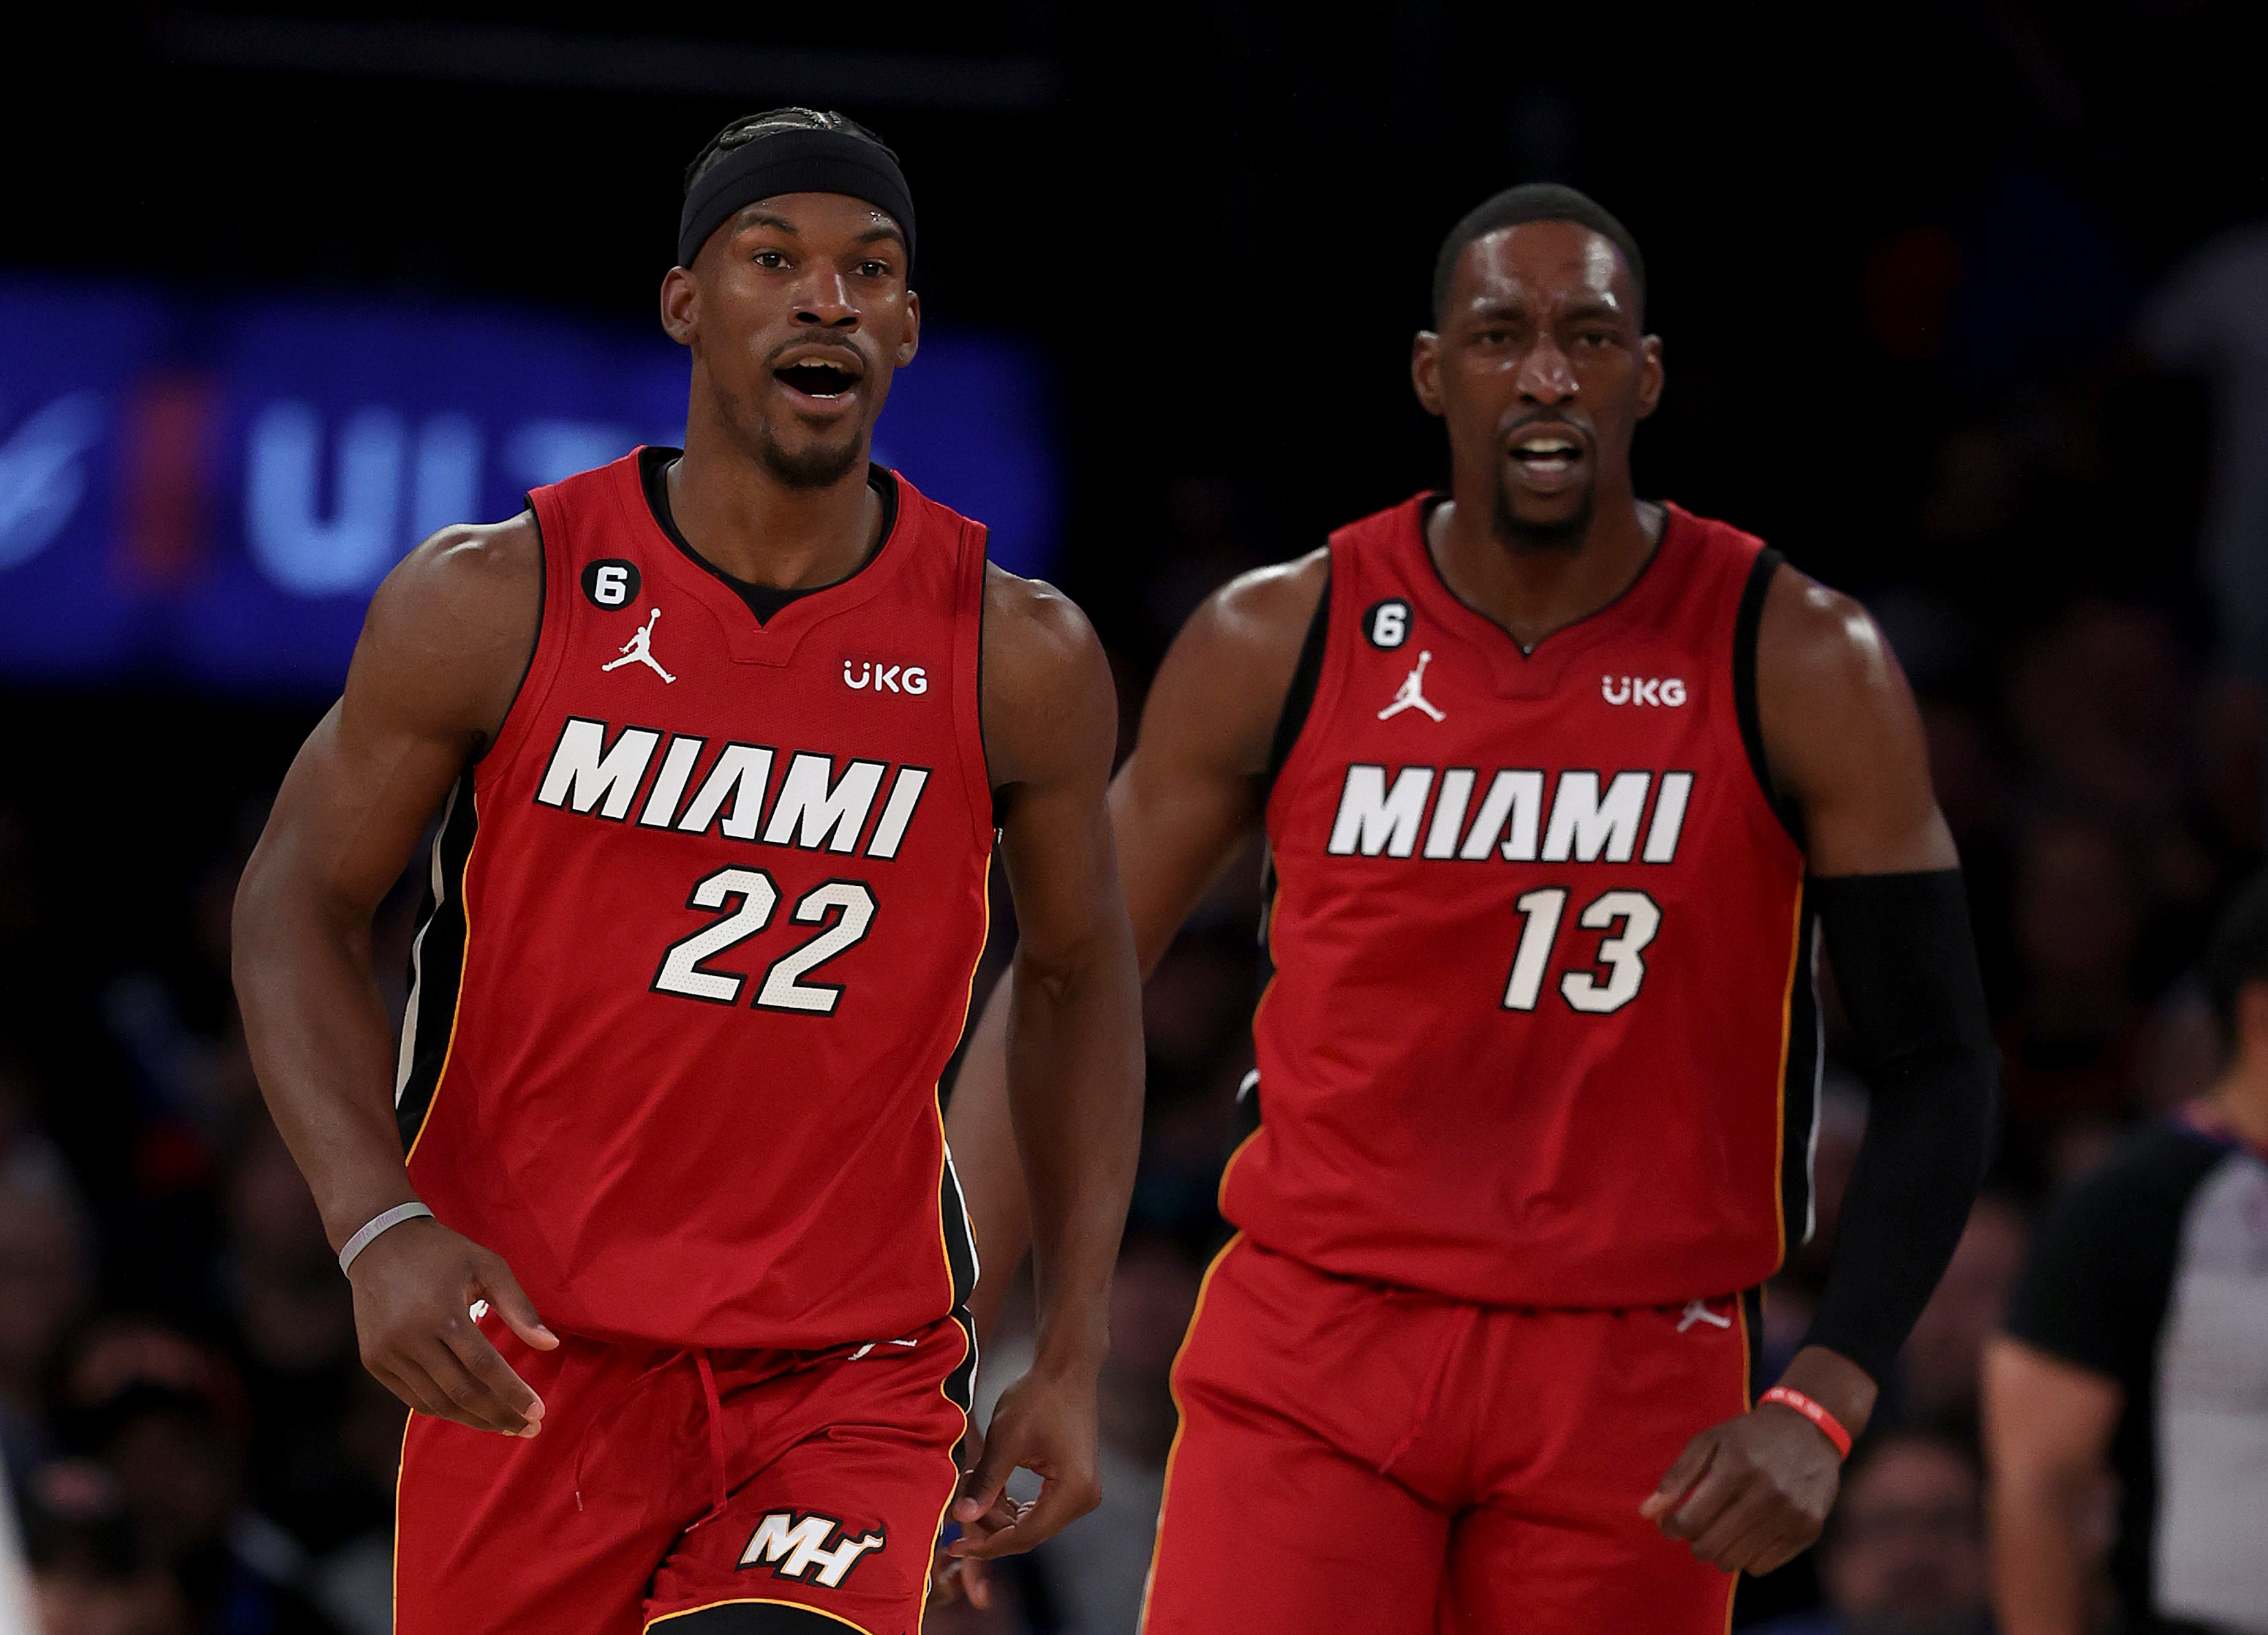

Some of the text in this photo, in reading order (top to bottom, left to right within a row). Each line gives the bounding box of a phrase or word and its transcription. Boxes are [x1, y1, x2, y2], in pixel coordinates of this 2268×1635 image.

[594, 565, 628, 604] 6
[1372, 603, 1407, 647] 6
[534, 715, 933, 861] MIAMI
[1326, 763, 1695, 863] MIAMI
[649, 863, 880, 1016] 22
[1501, 887, 1663, 1014] 13
